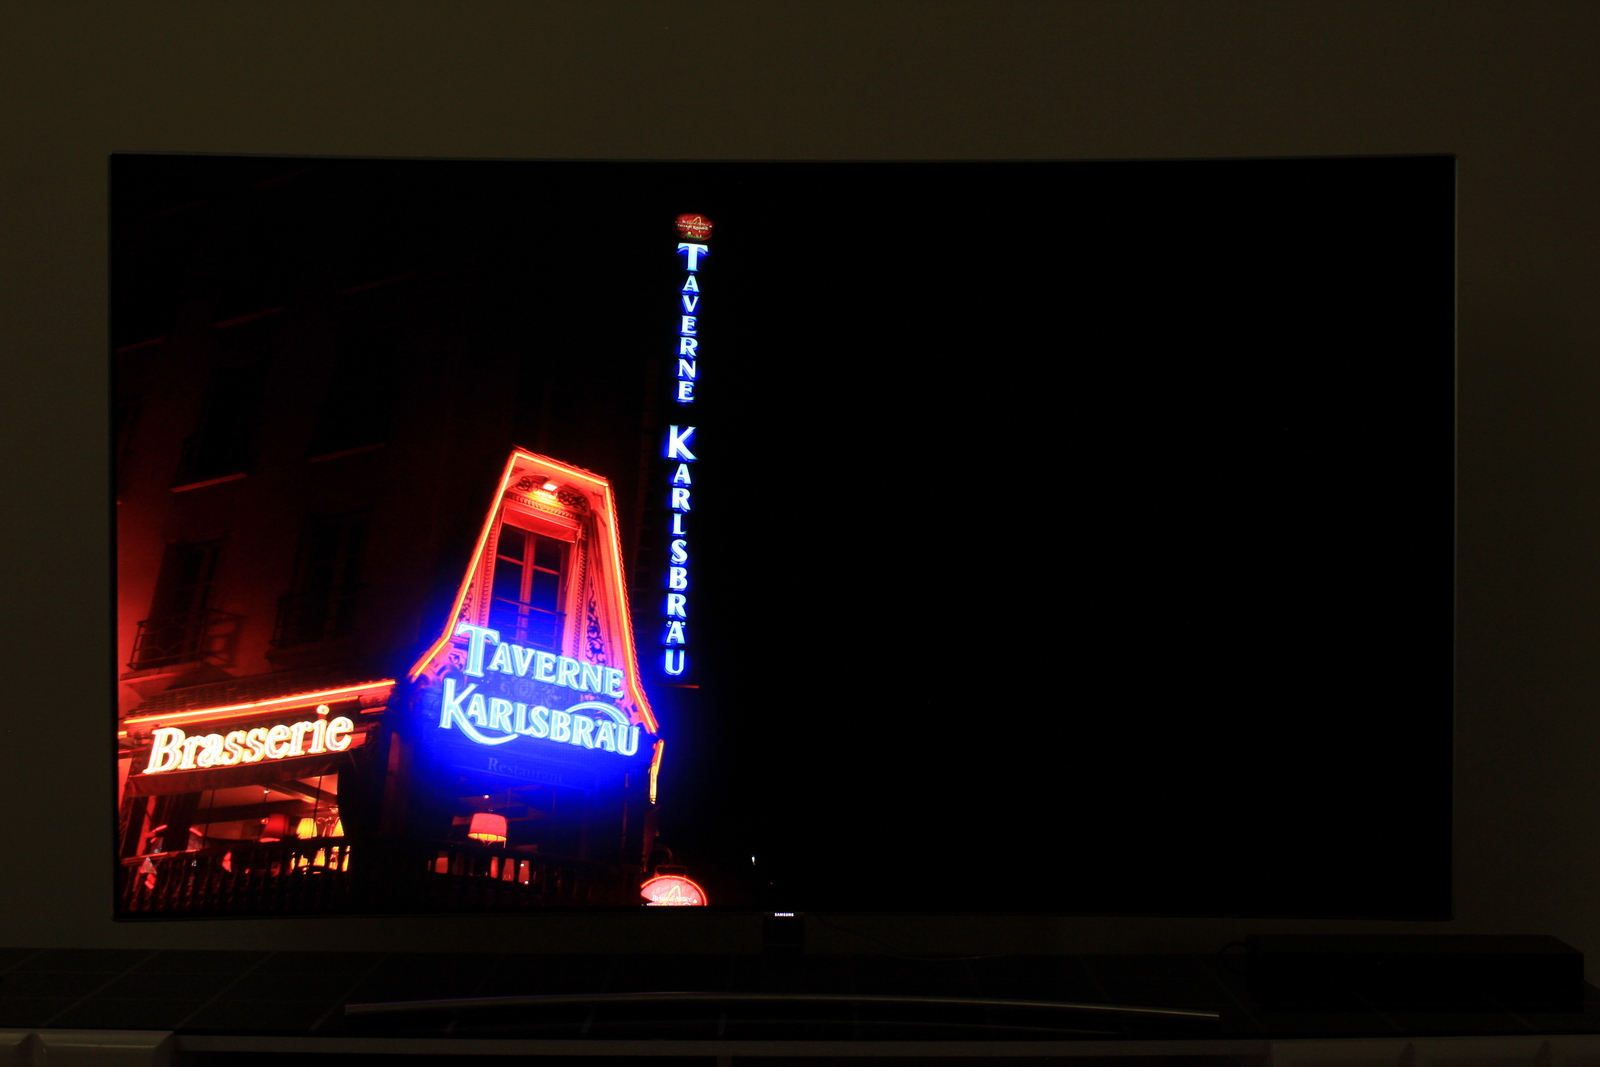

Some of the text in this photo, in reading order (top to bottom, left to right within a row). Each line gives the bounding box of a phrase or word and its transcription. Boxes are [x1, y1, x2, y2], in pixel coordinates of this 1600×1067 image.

[677, 242, 709, 404] TAVERNE
[664, 425, 698, 677] KARLSBRÄU
[455, 623, 624, 697] TAVERNE
[143, 704, 355, 774] Brasserie
[439, 678, 642, 757] KARLSBRÄU
[487, 756, 563, 783] Restaurant
